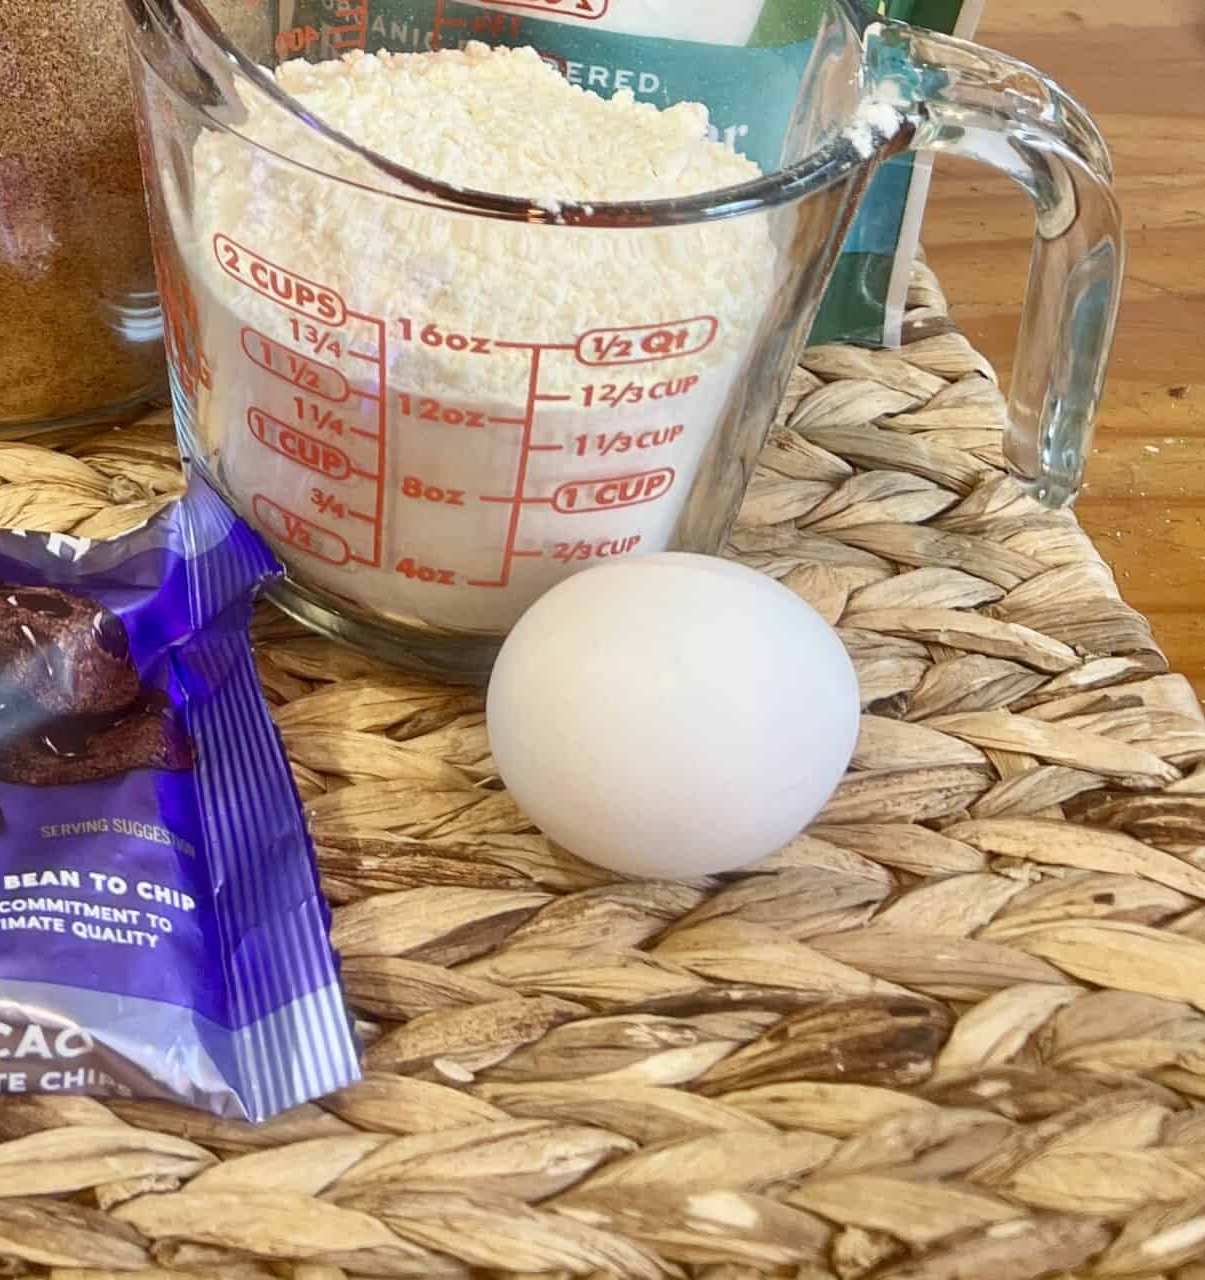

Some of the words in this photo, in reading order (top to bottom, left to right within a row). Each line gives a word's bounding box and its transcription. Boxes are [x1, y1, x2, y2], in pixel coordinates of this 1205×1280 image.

[221, 245, 240, 272] 2
[249, 261, 338, 321] CUPS
[397, 318, 491, 355] 16oz
[640, 330, 689, 354] Qt
[259, 346, 274, 369] 1
[648, 375, 700, 400] CUP
[397, 392, 486, 428] 12oz
[254, 415, 265, 439] 1
[279, 428, 344, 475] CUP
[636, 424, 685, 449] CUP
[310, 487, 347, 520] 3/4
[401, 477, 466, 506] 8oz
[563, 488, 578, 508] 1
[595, 475, 667, 504] CUP
[284, 510, 312, 544] 1/2
[551, 542, 592, 563] 2/3
[595, 535, 641, 557] CUP
[395, 557, 457, 585] 4oz
[41, 818, 109, 839] SERVING
[3, 869, 82, 890] BEAN
[89, 871, 128, 897] TO
[136, 881, 196, 911] CHIP
[71, 921, 160, 949] QUALITY
[146, 913, 173, 934] TO
